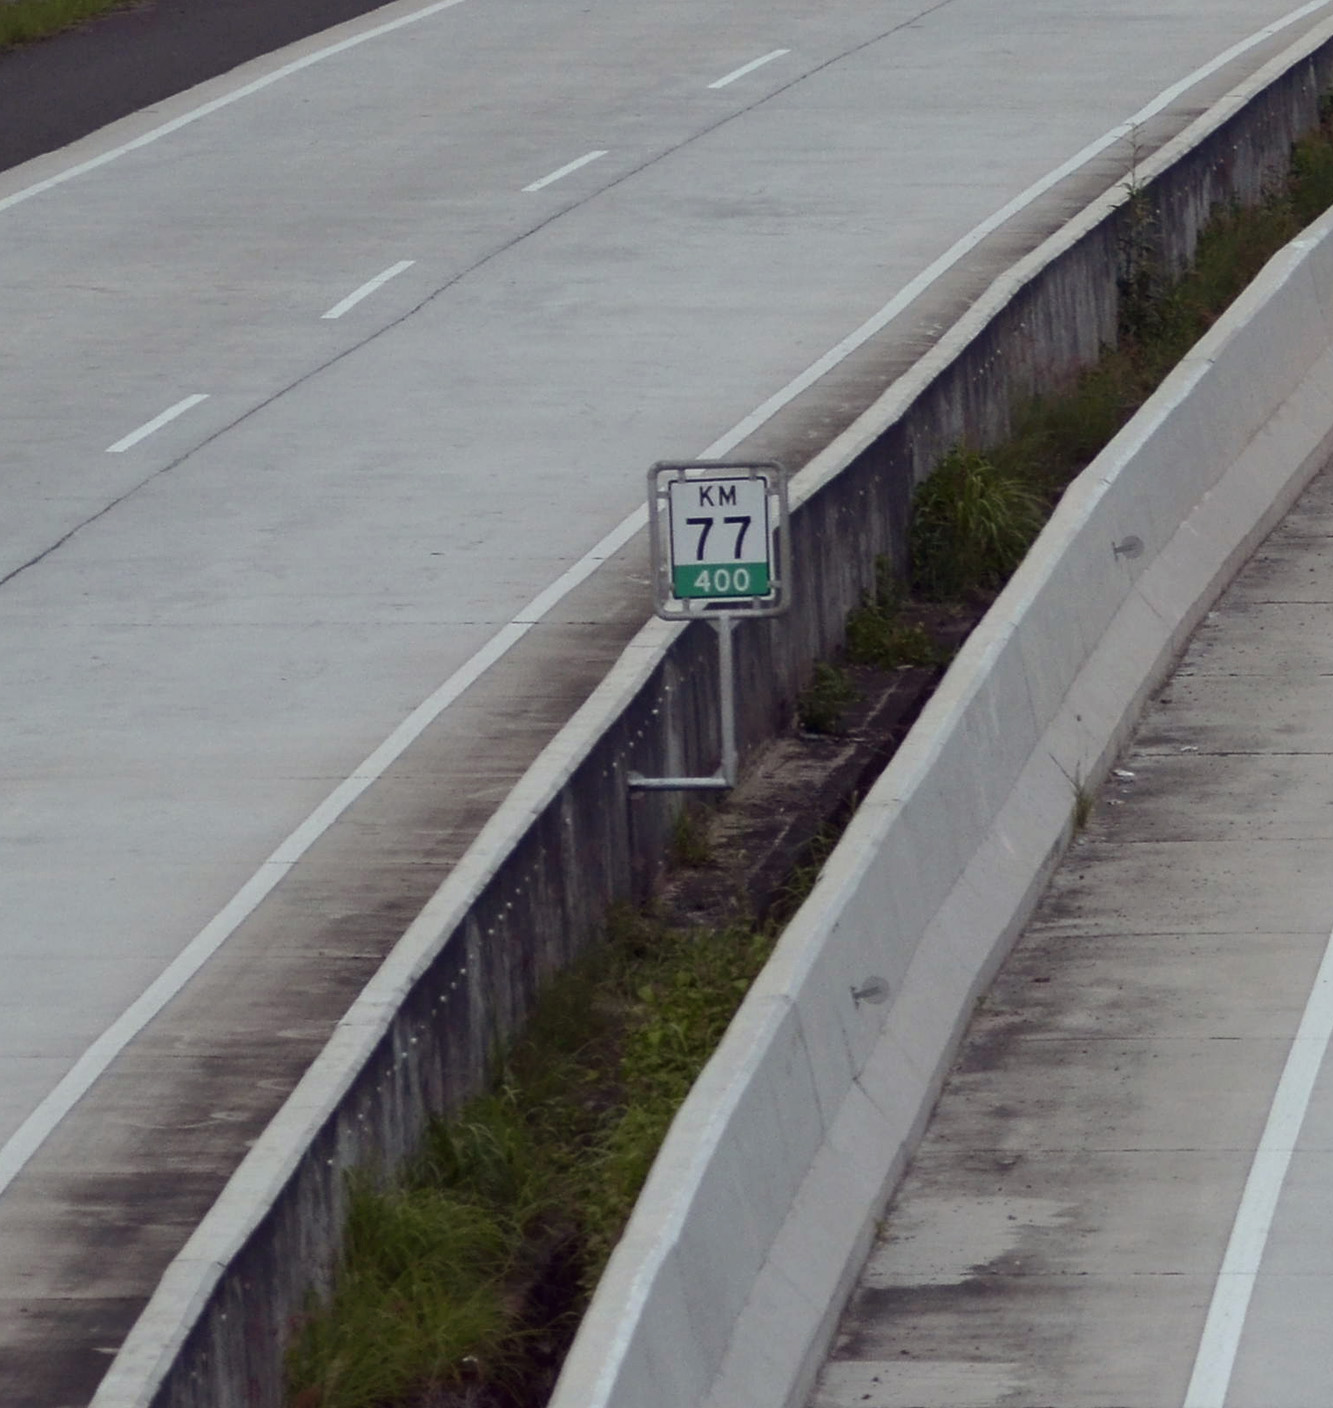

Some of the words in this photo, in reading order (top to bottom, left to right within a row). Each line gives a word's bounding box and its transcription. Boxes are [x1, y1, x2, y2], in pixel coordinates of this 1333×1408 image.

[699, 485, 737, 507] KM
[685, 516, 752, 561] 77
[693, 568, 750, 593] 400
